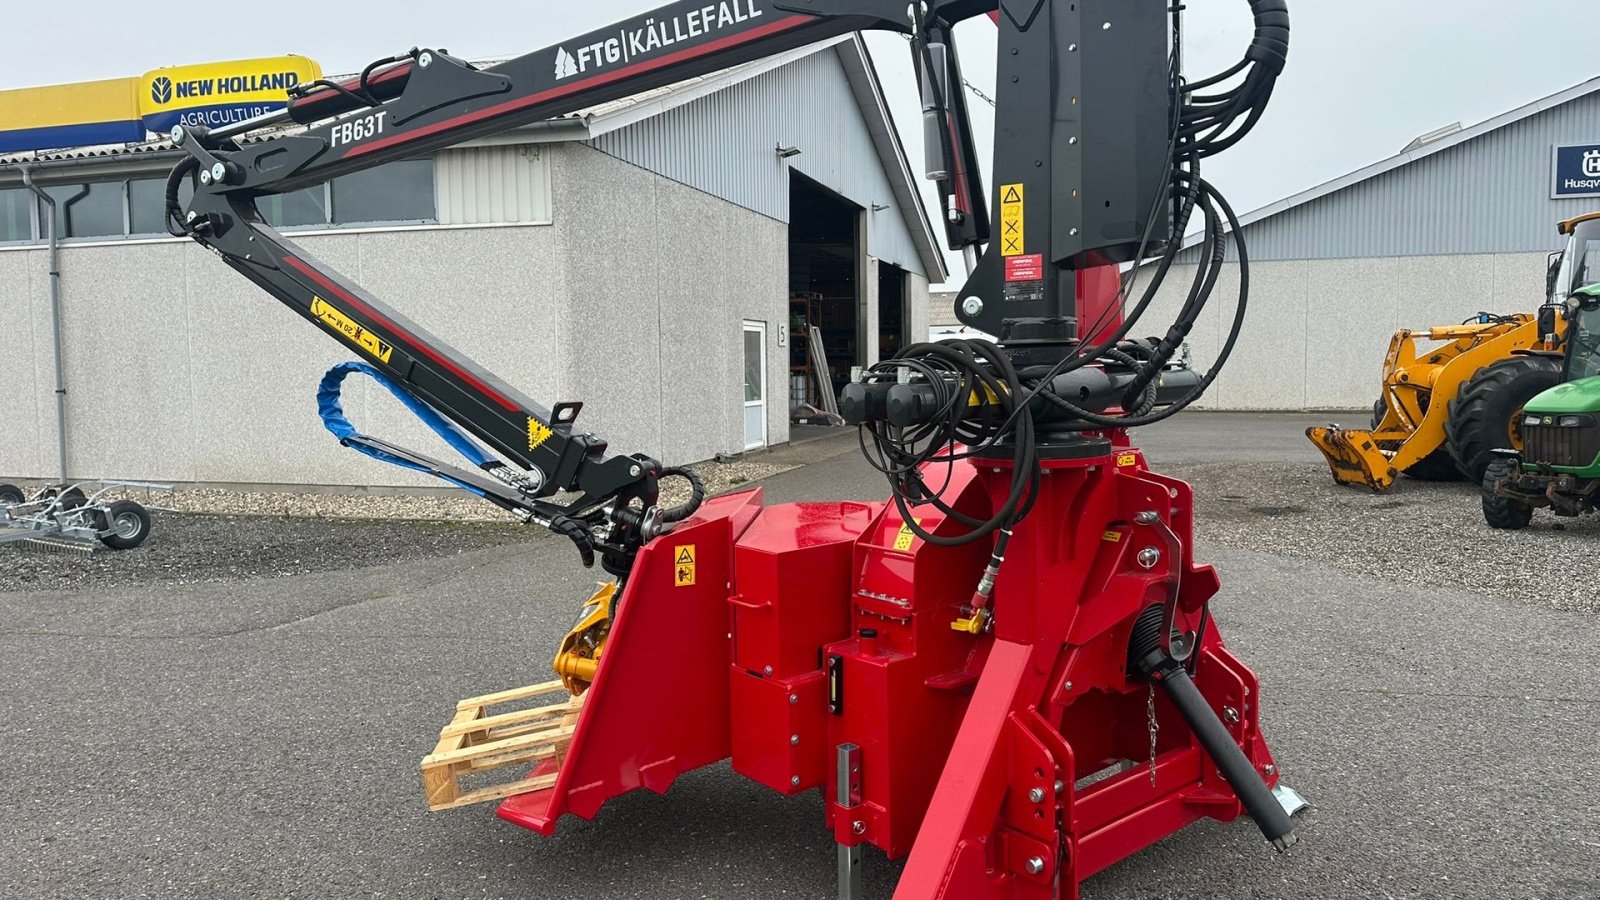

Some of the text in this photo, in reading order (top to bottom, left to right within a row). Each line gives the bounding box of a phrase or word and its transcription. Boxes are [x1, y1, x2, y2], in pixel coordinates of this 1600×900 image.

[577, 0, 763, 73] FTG KÄLLEFALL
[176, 72, 298, 98] NEW HOLLAND
[331, 111, 387, 148] FB63T
[1564, 179, 1600, 188] Husqv
[336, 319, 353, 334] 20 M
[781, 326, 785, 342] 5
